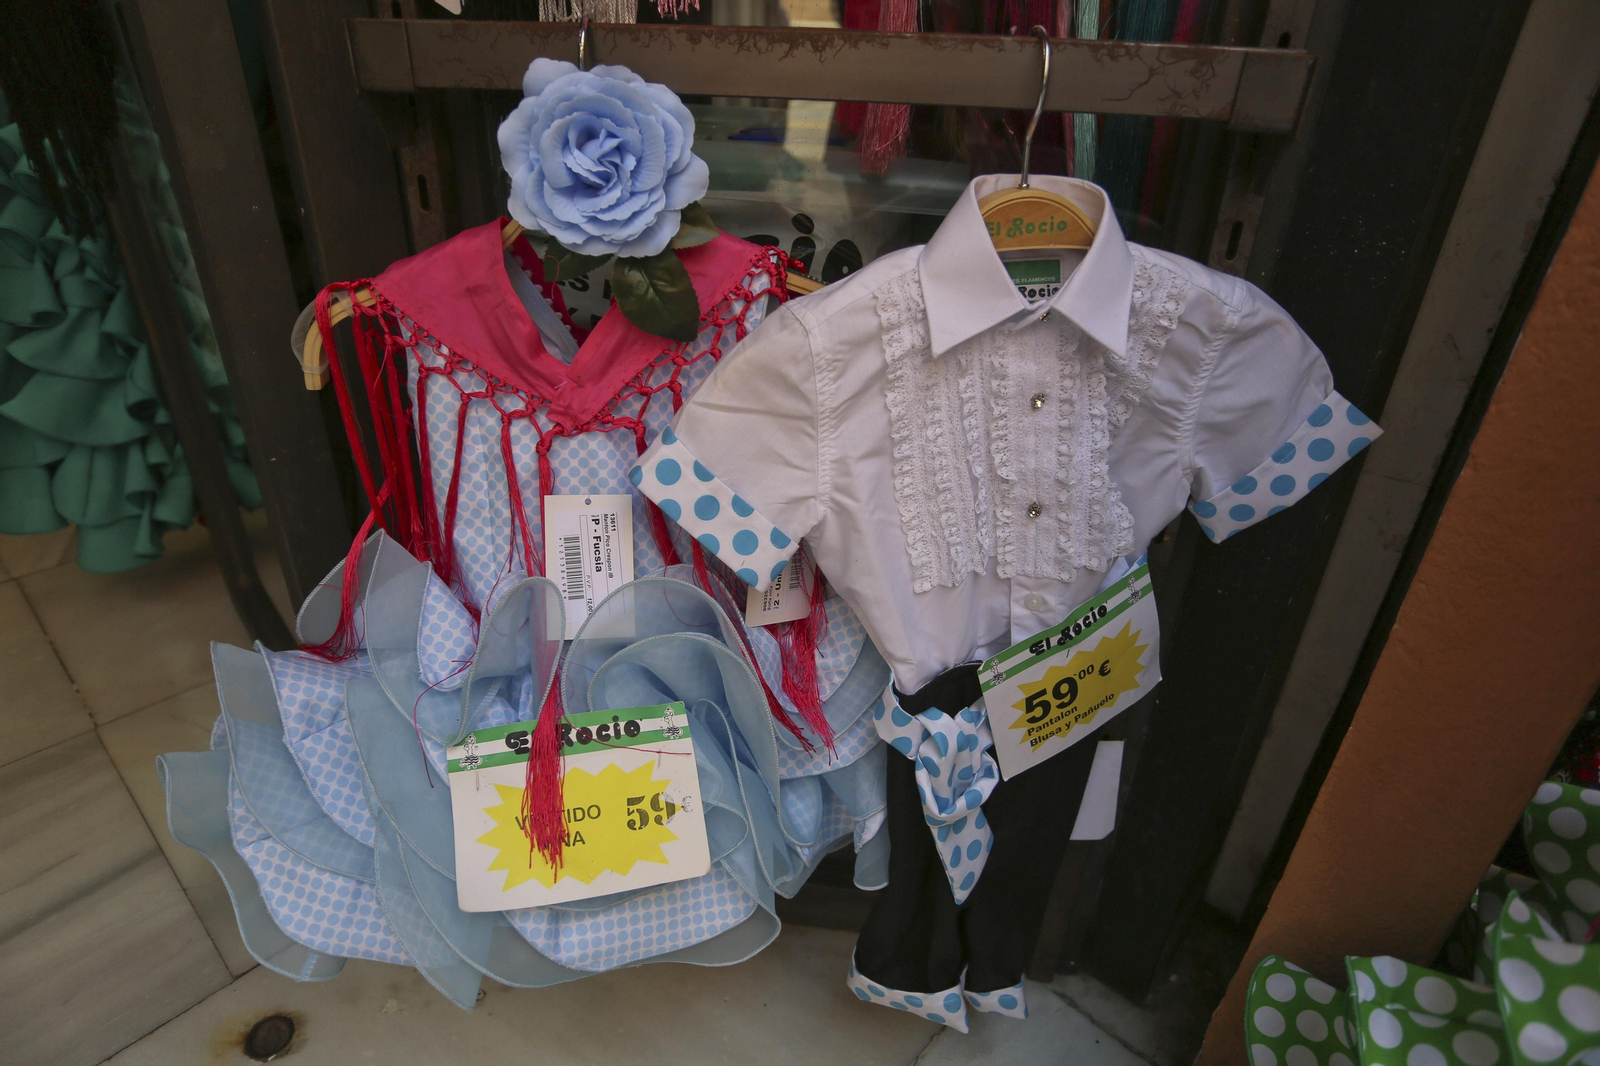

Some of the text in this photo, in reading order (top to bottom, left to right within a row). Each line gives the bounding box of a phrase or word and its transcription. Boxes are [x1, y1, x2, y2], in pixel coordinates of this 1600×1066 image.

[985, 215, 1068, 239] El Rocio
[593, 535, 603, 573] Fucsia
[1029, 606, 1107, 656] El Rocio
[1027, 706, 1078, 736] Pantalon
[1030, 693, 1115, 747] Blusa y Pañuelo
[627, 792, 675, 831] 59
